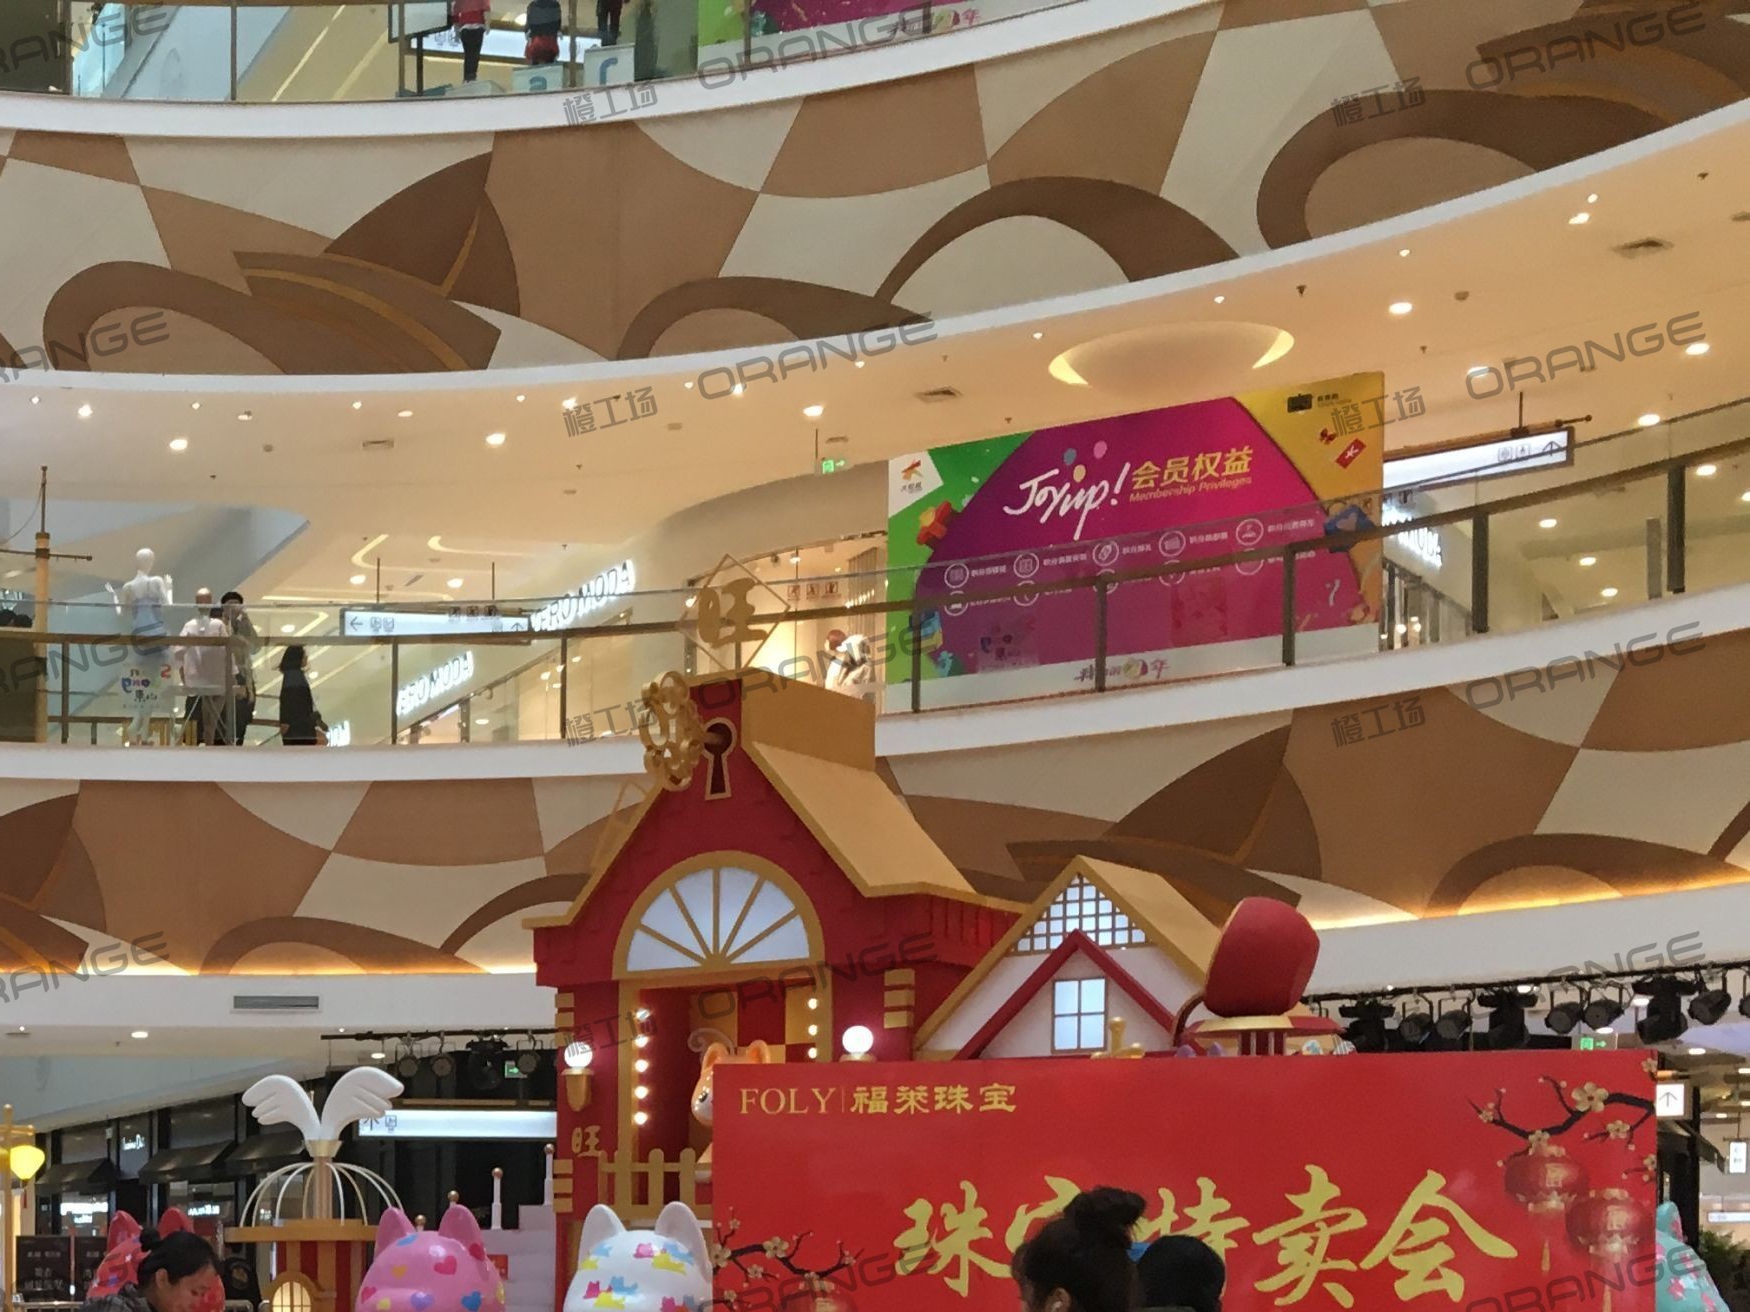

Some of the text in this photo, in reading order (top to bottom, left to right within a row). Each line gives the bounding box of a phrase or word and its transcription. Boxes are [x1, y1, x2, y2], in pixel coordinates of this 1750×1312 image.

[1131, 445, 1253, 490] 会员权益
[1129, 485, 1196, 503] Membership
[739, 1082, 1017, 1115] FOLY 福莱珠宝
[571, 1126, 601, 1158] 旺
